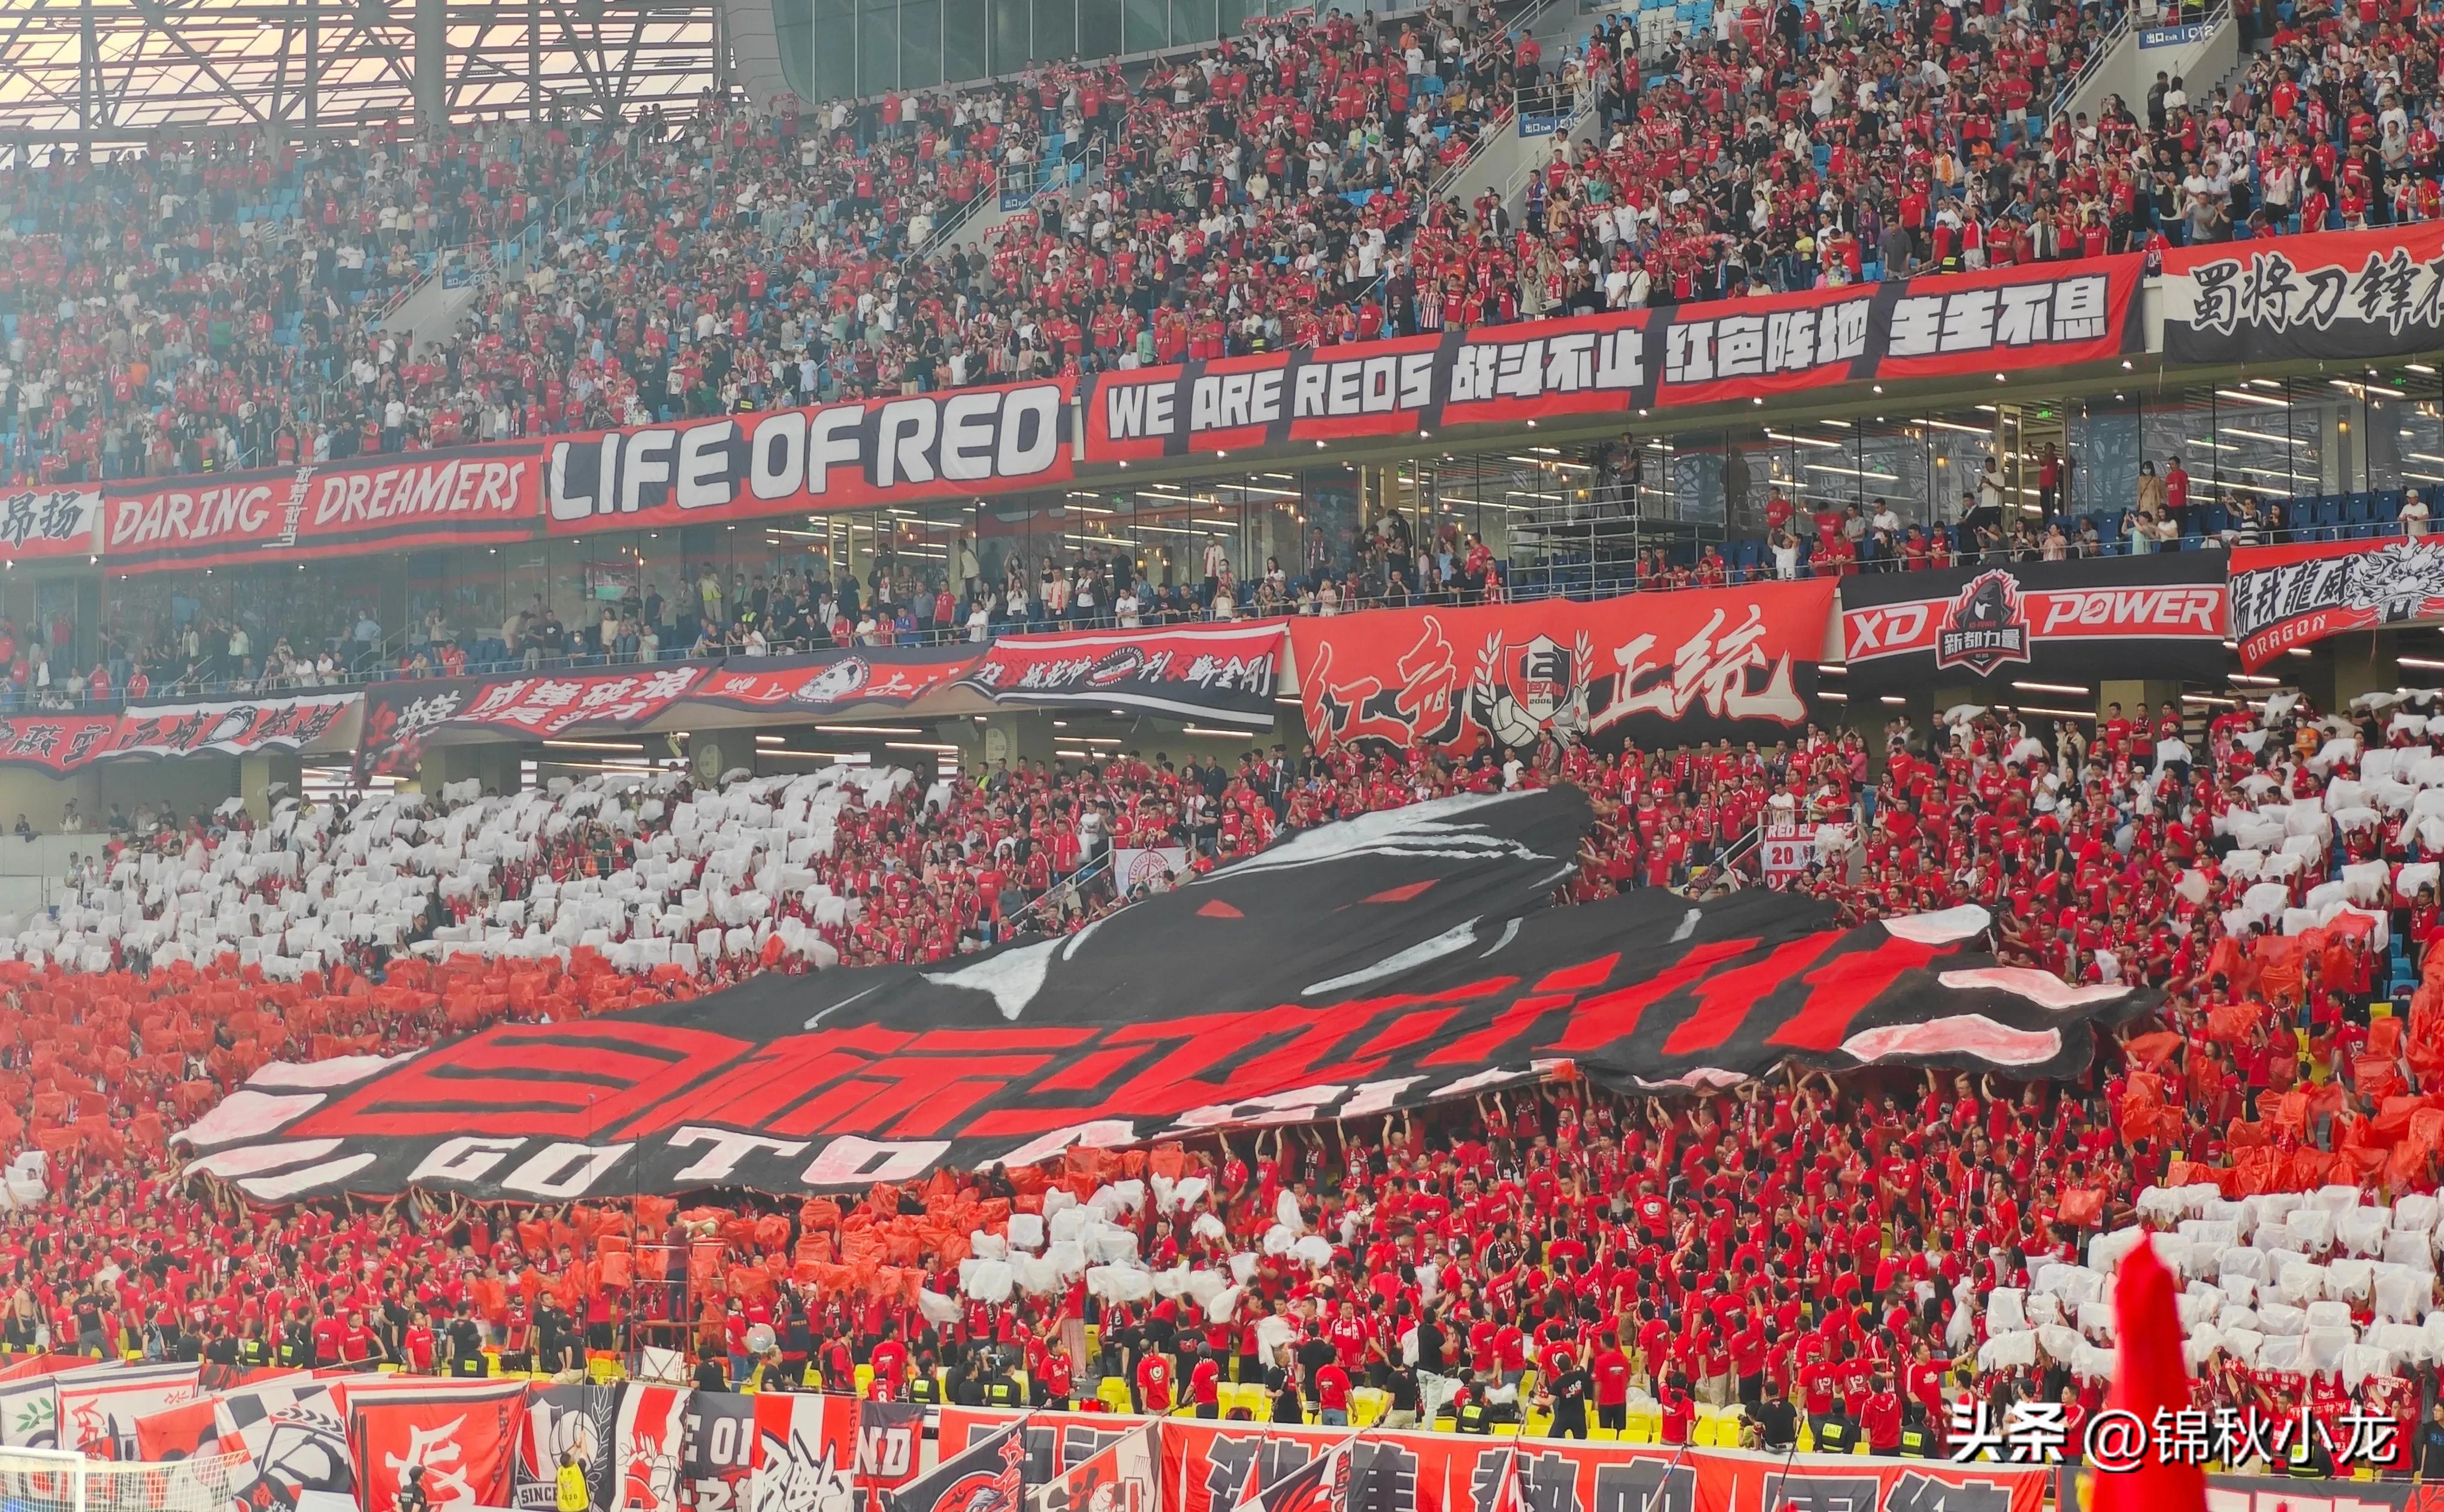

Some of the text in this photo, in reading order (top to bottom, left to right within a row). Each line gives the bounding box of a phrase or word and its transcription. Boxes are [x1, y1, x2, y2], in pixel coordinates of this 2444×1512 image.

[2146, 32, 2164, 44] 出口
[1525, 123, 1540, 133] 出口
[1665, 276, 2107, 383] 红色阵地 生生不息
[1108, 382, 1175, 439] WE
[1190, 369, 1283, 431] ARE
[1450, 329, 1643, 403] 战斗不止
[550, 385, 1060, 521] LIFE OF RED
[111, 458, 524, 545] DARING DREAMERS
[1850, 590, 2219, 657] XD POWER
[1944, 629, 2020, 655] 新都力量
[2248, 614, 2327, 661] DRAGON
[1592, 605, 1808, 736] 正统
[1768, 824, 1795, 837] RED
[407, 1136, 636, 1197] GO
[666, 1126, 951, 1184] TO
[1499, 1289, 1514, 1310] 12
